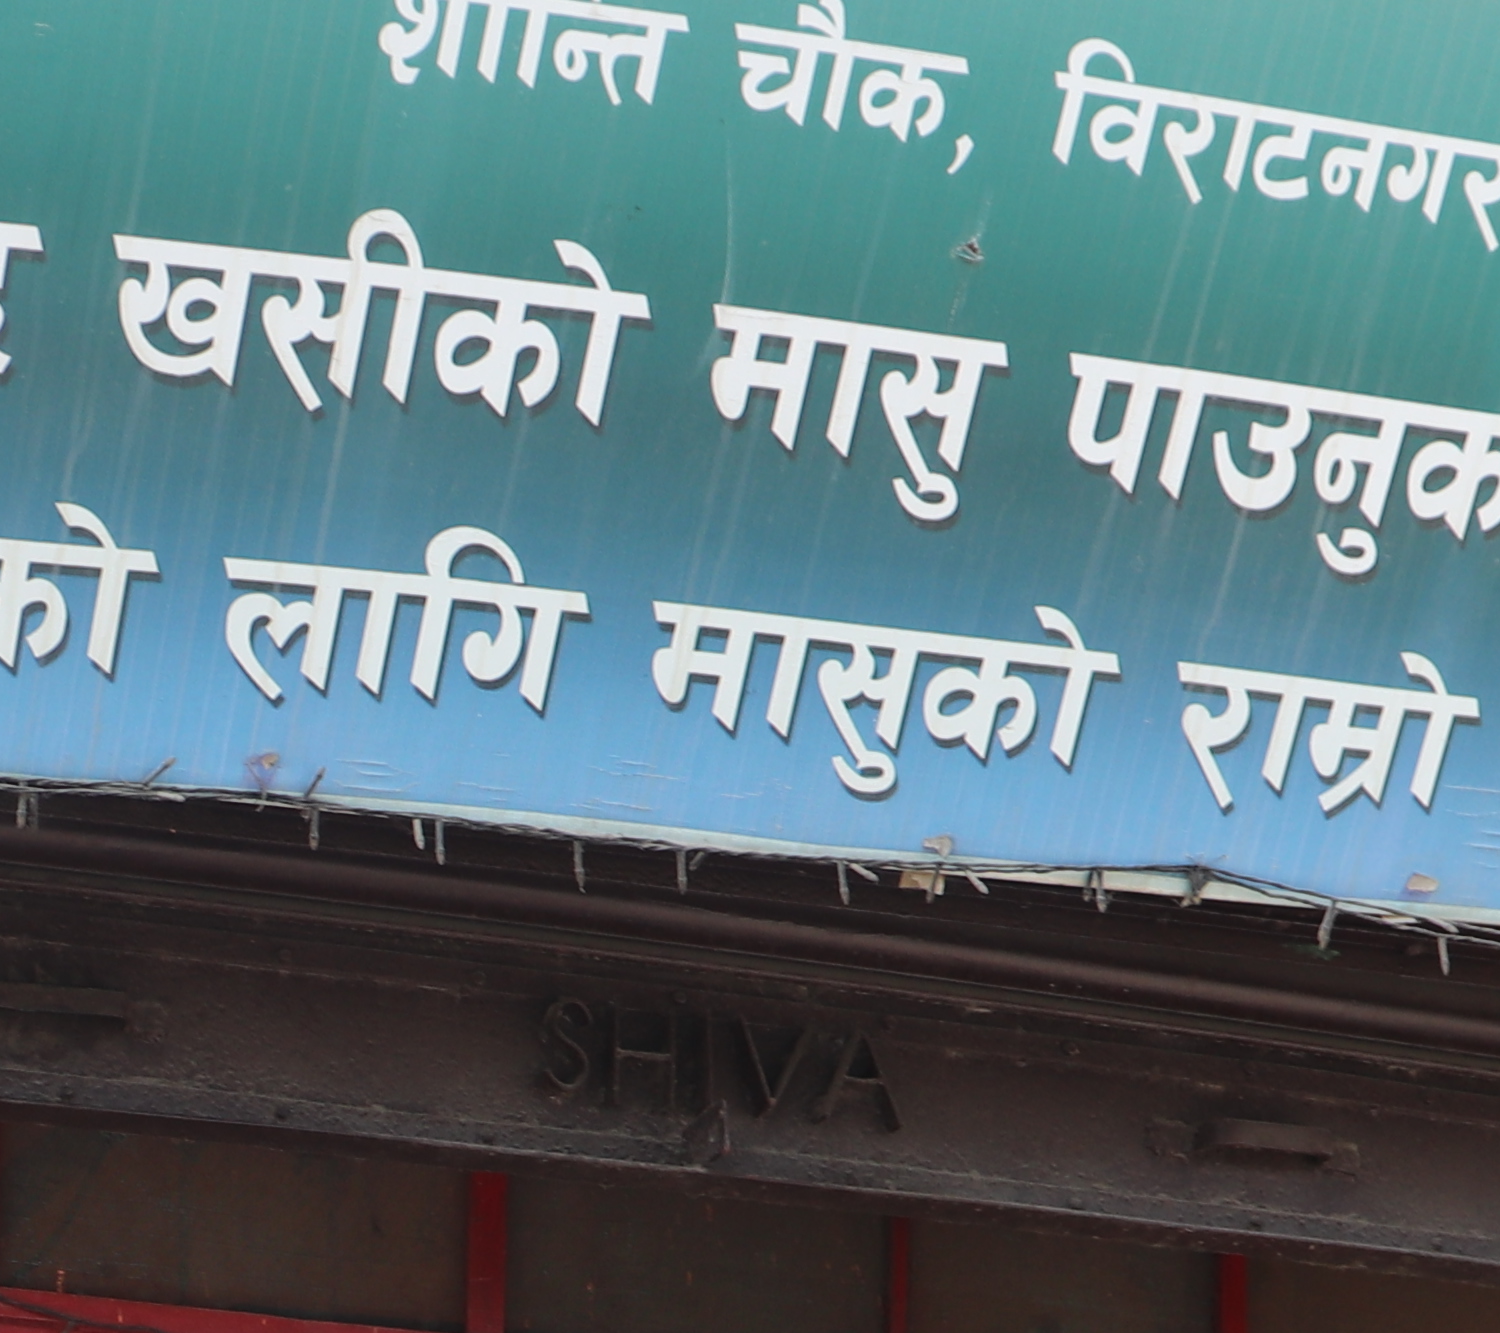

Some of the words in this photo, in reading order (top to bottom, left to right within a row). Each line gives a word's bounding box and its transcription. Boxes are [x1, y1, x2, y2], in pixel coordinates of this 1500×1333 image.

[734, 0, 974, 175] चौक,
[113, 209, 651, 427] खसीको
[711, 303, 1009, 521] मासु
[223, 526, 590, 714] लागि
[651, 600, 1121, 794] मासुको
[1177, 652, 1480, 812] राम्रो
[540, 996, 902, 1132] SHIVA
